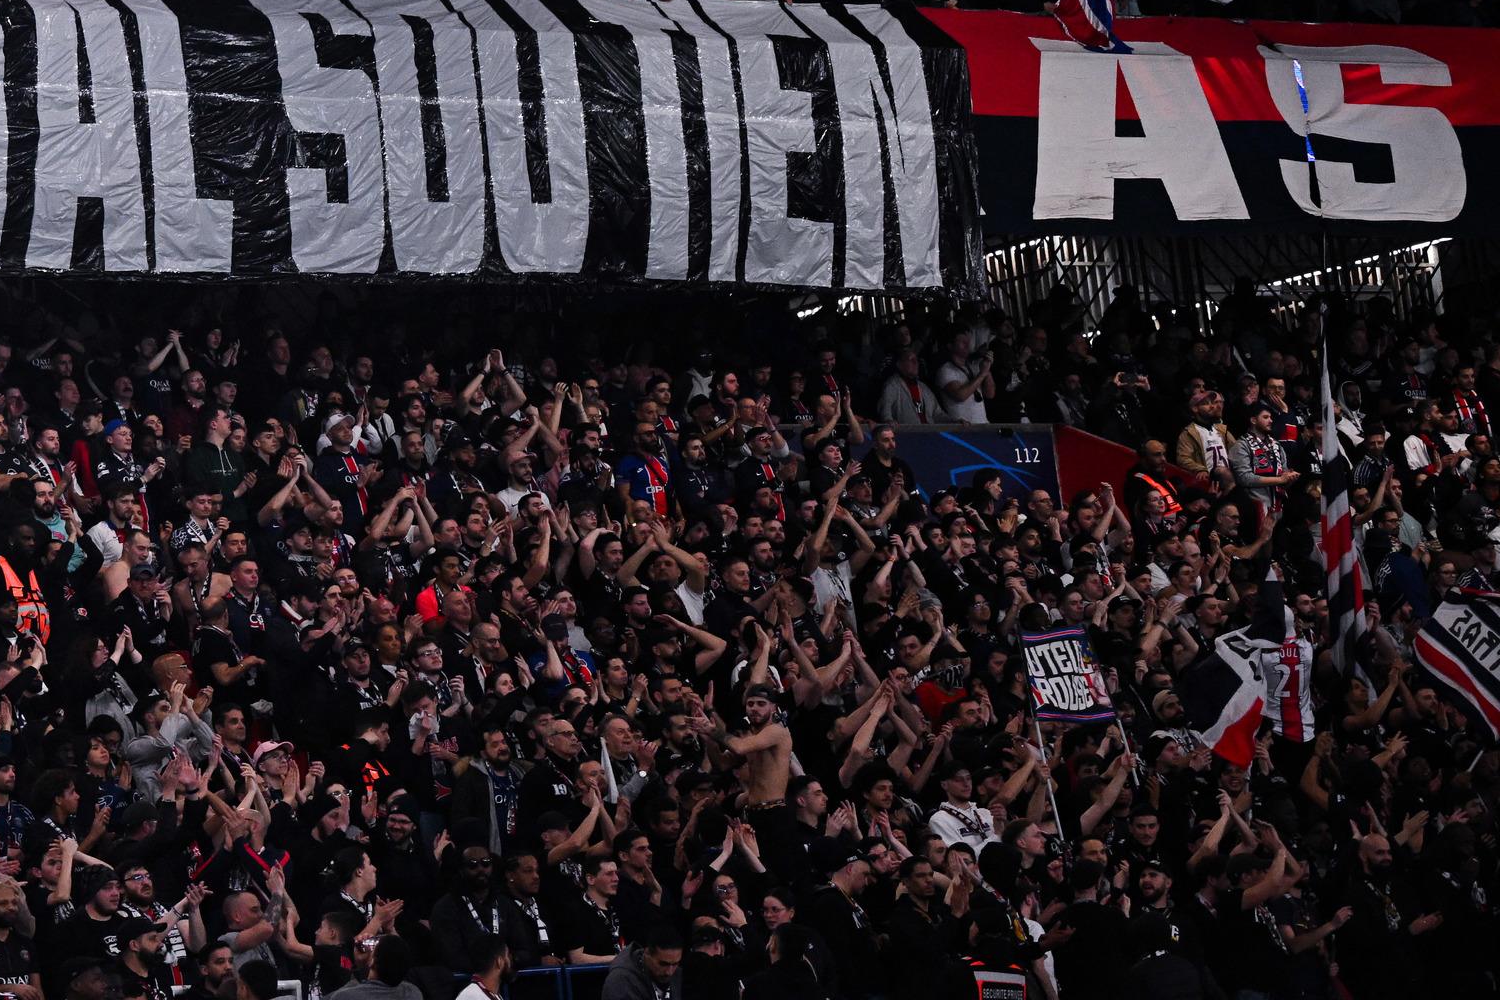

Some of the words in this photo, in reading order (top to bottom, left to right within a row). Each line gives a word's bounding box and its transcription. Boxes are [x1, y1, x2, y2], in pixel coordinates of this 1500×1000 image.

[1015, 447, 1041, 463] 112
[344, 475, 359, 484] QAT
[1273, 664, 1305, 698] 21
[551, 783, 568, 796] 19
